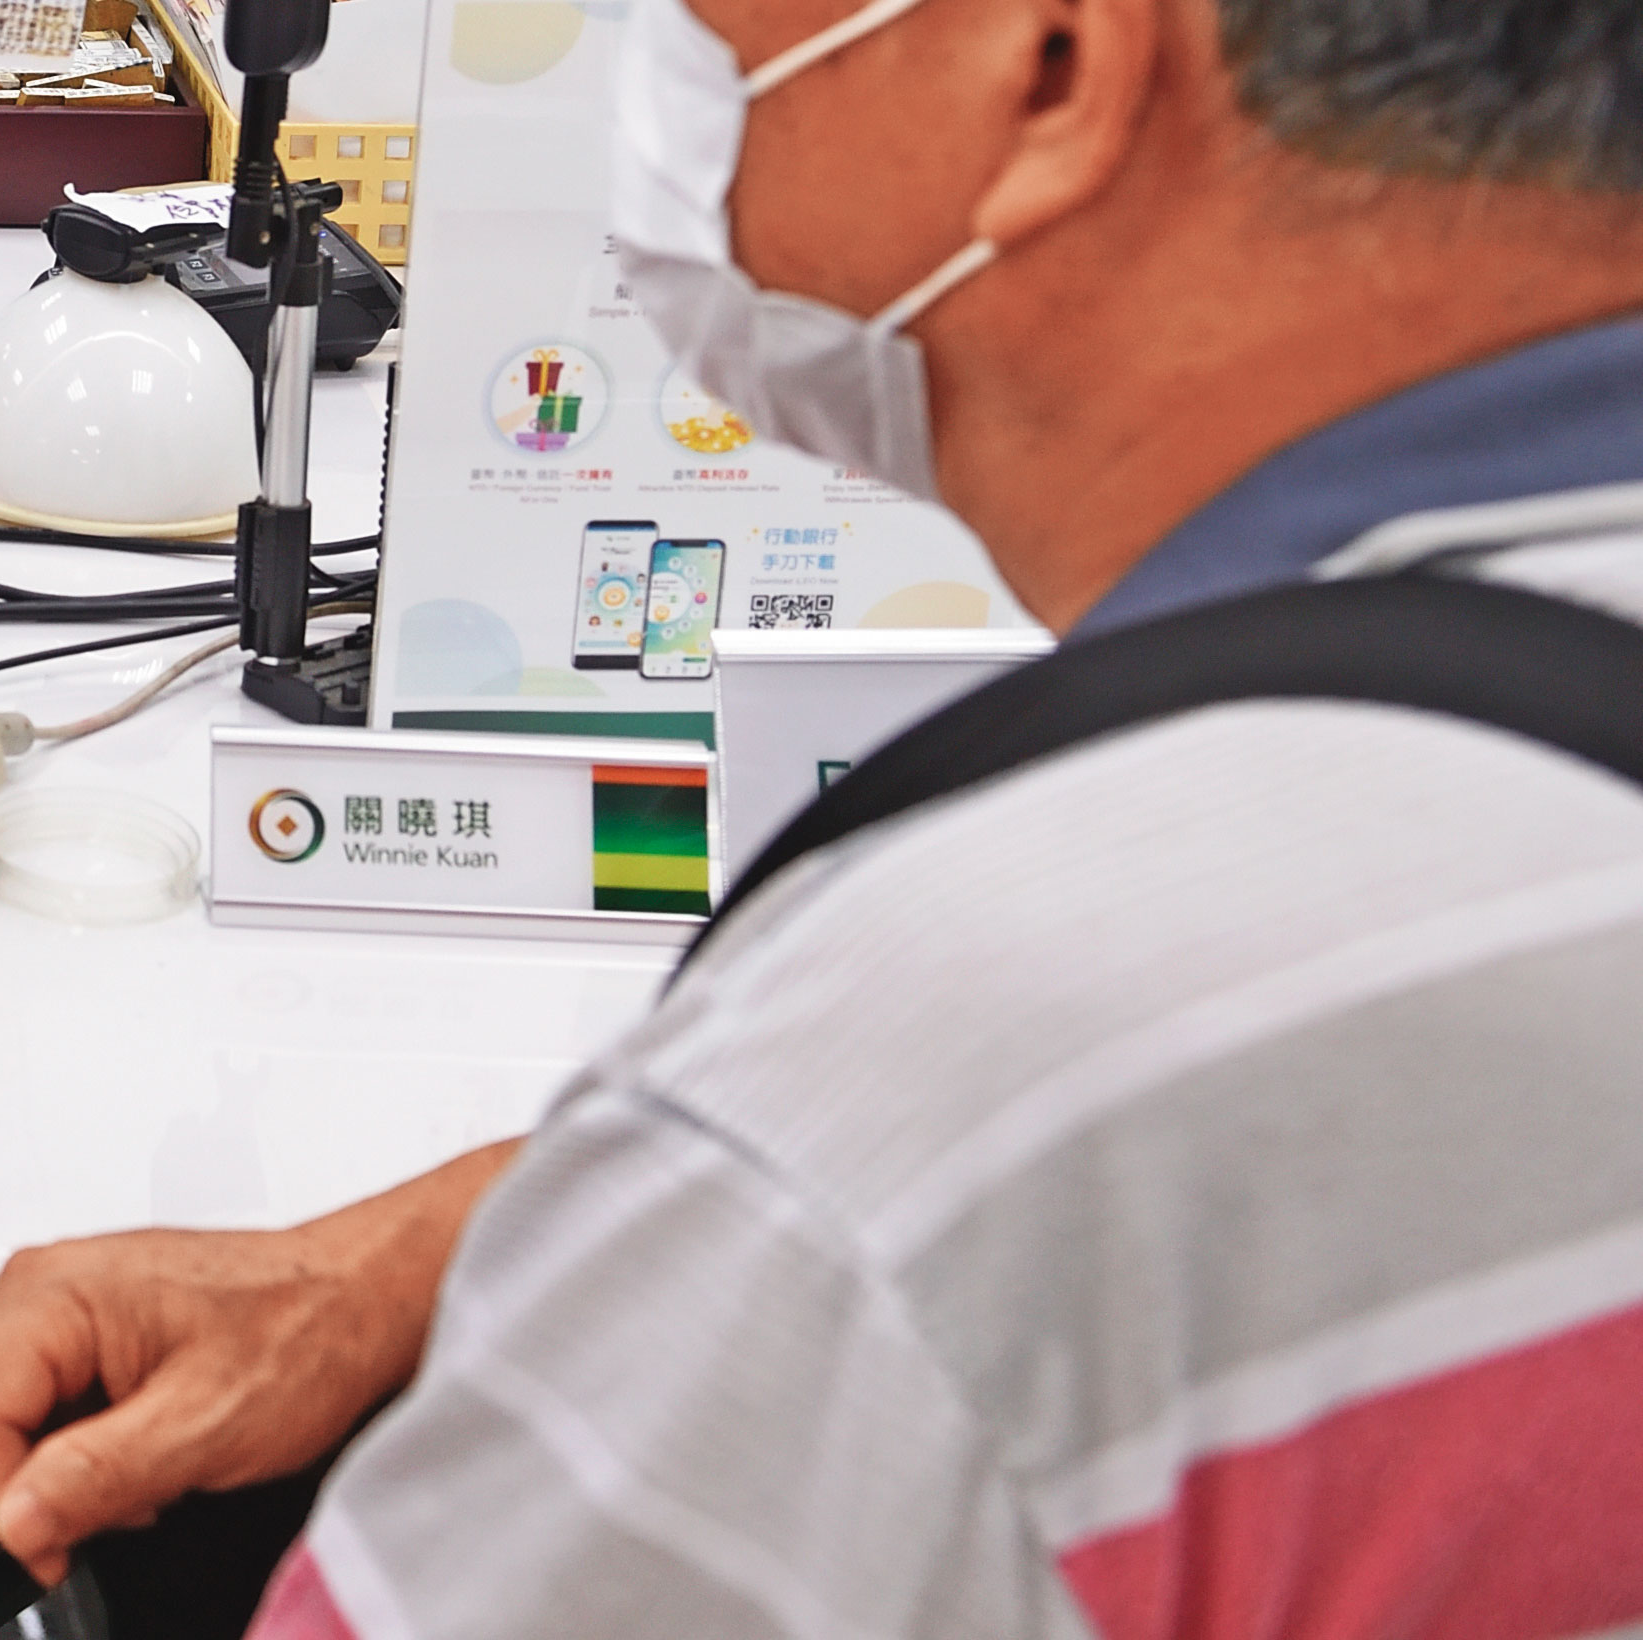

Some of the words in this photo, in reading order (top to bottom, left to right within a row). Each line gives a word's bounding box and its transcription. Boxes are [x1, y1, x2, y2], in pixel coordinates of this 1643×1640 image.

[764, 528, 838, 545] 行動銀行
[761, 554, 836, 571] 手刀下載
[343, 842, 428, 869] Winnie
[437, 845, 499, 870] Kuan
